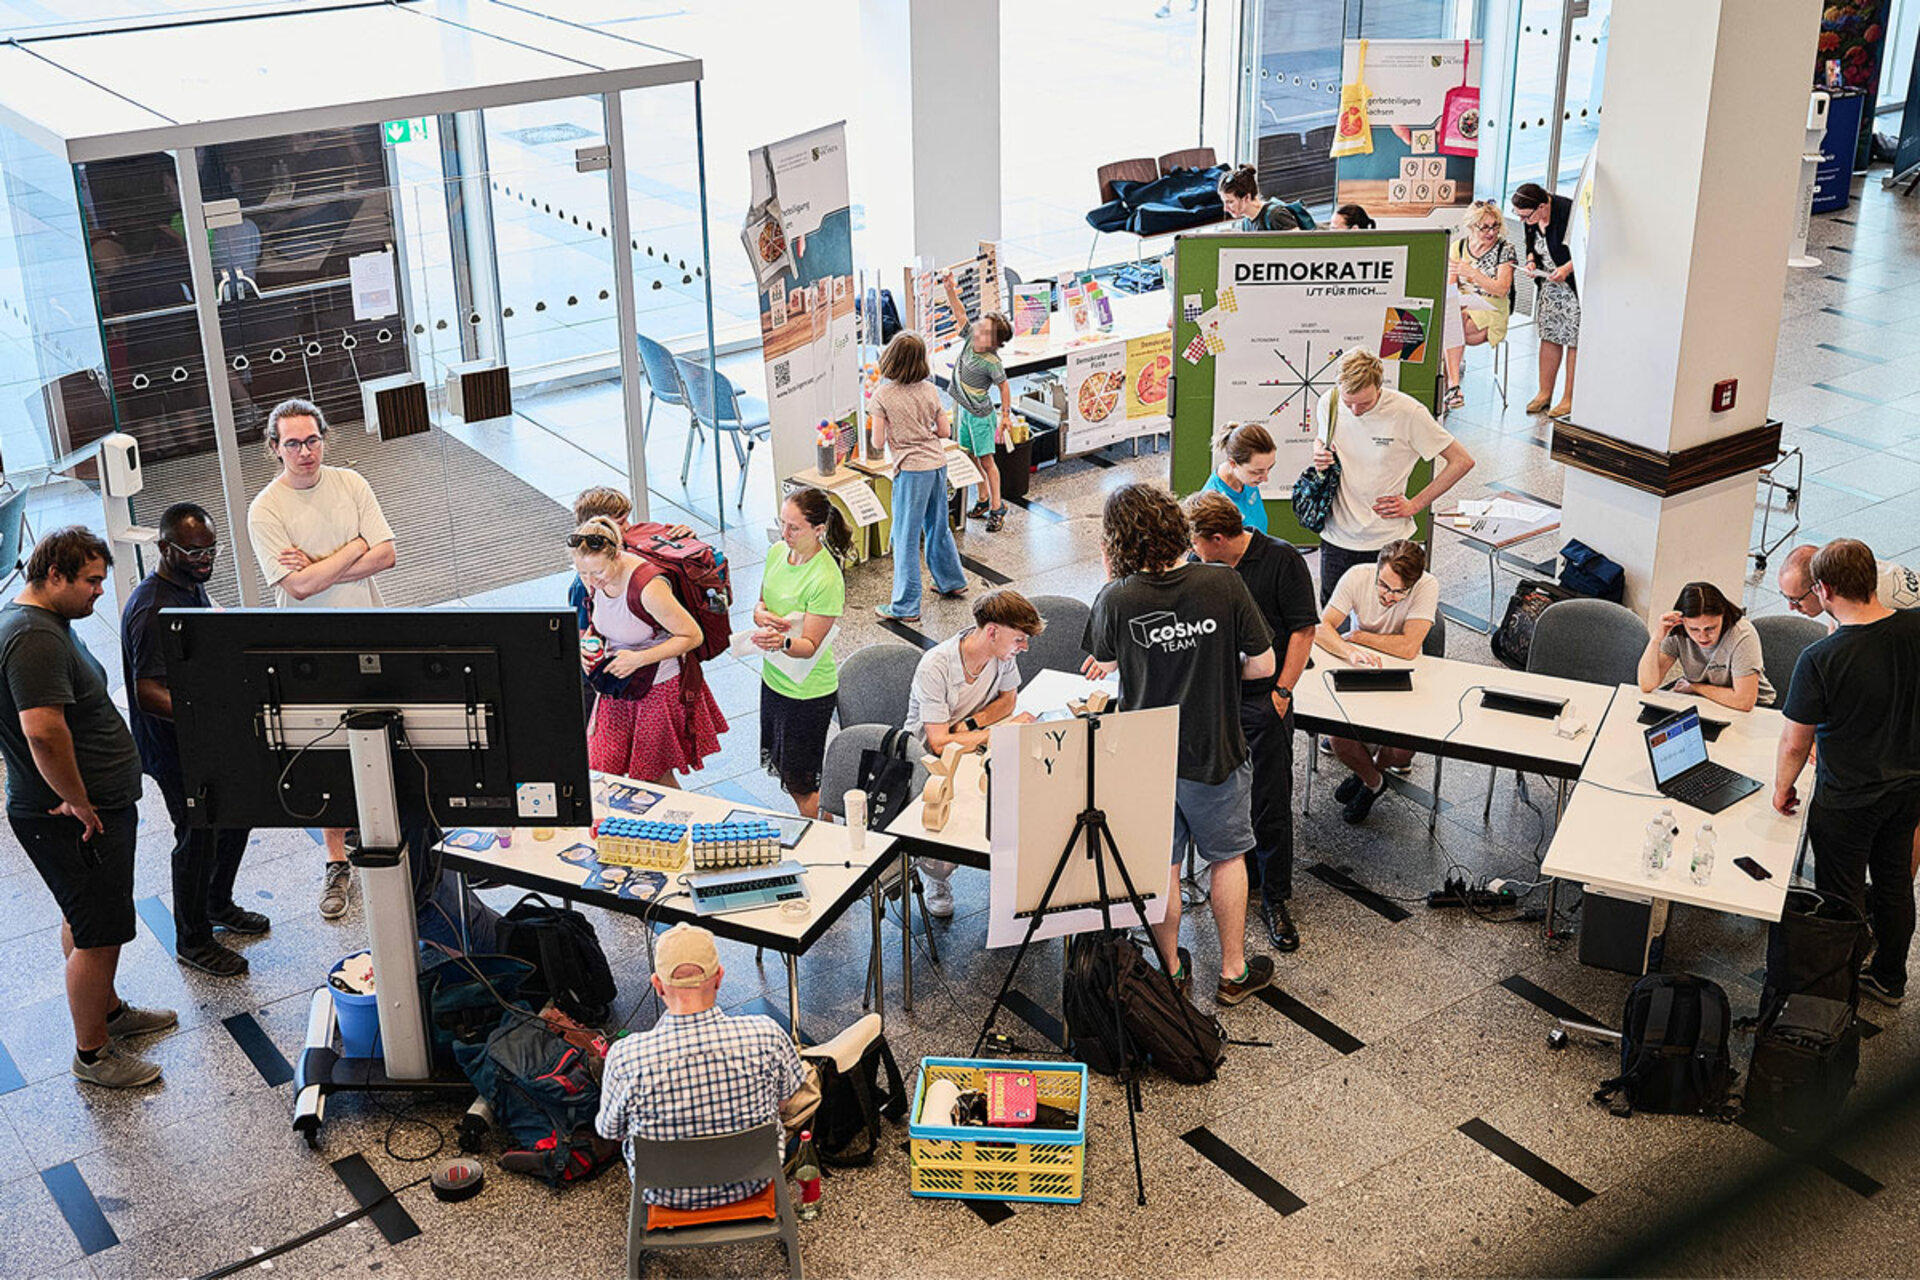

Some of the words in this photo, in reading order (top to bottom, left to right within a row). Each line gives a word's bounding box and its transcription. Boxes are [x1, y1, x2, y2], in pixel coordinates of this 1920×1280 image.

[1235, 261, 1394, 282] DEMOKRATIE
[1325, 284, 1347, 297] FÜR
[1149, 618, 1217, 643] COSMO
[1161, 637, 1197, 653] TEAM
